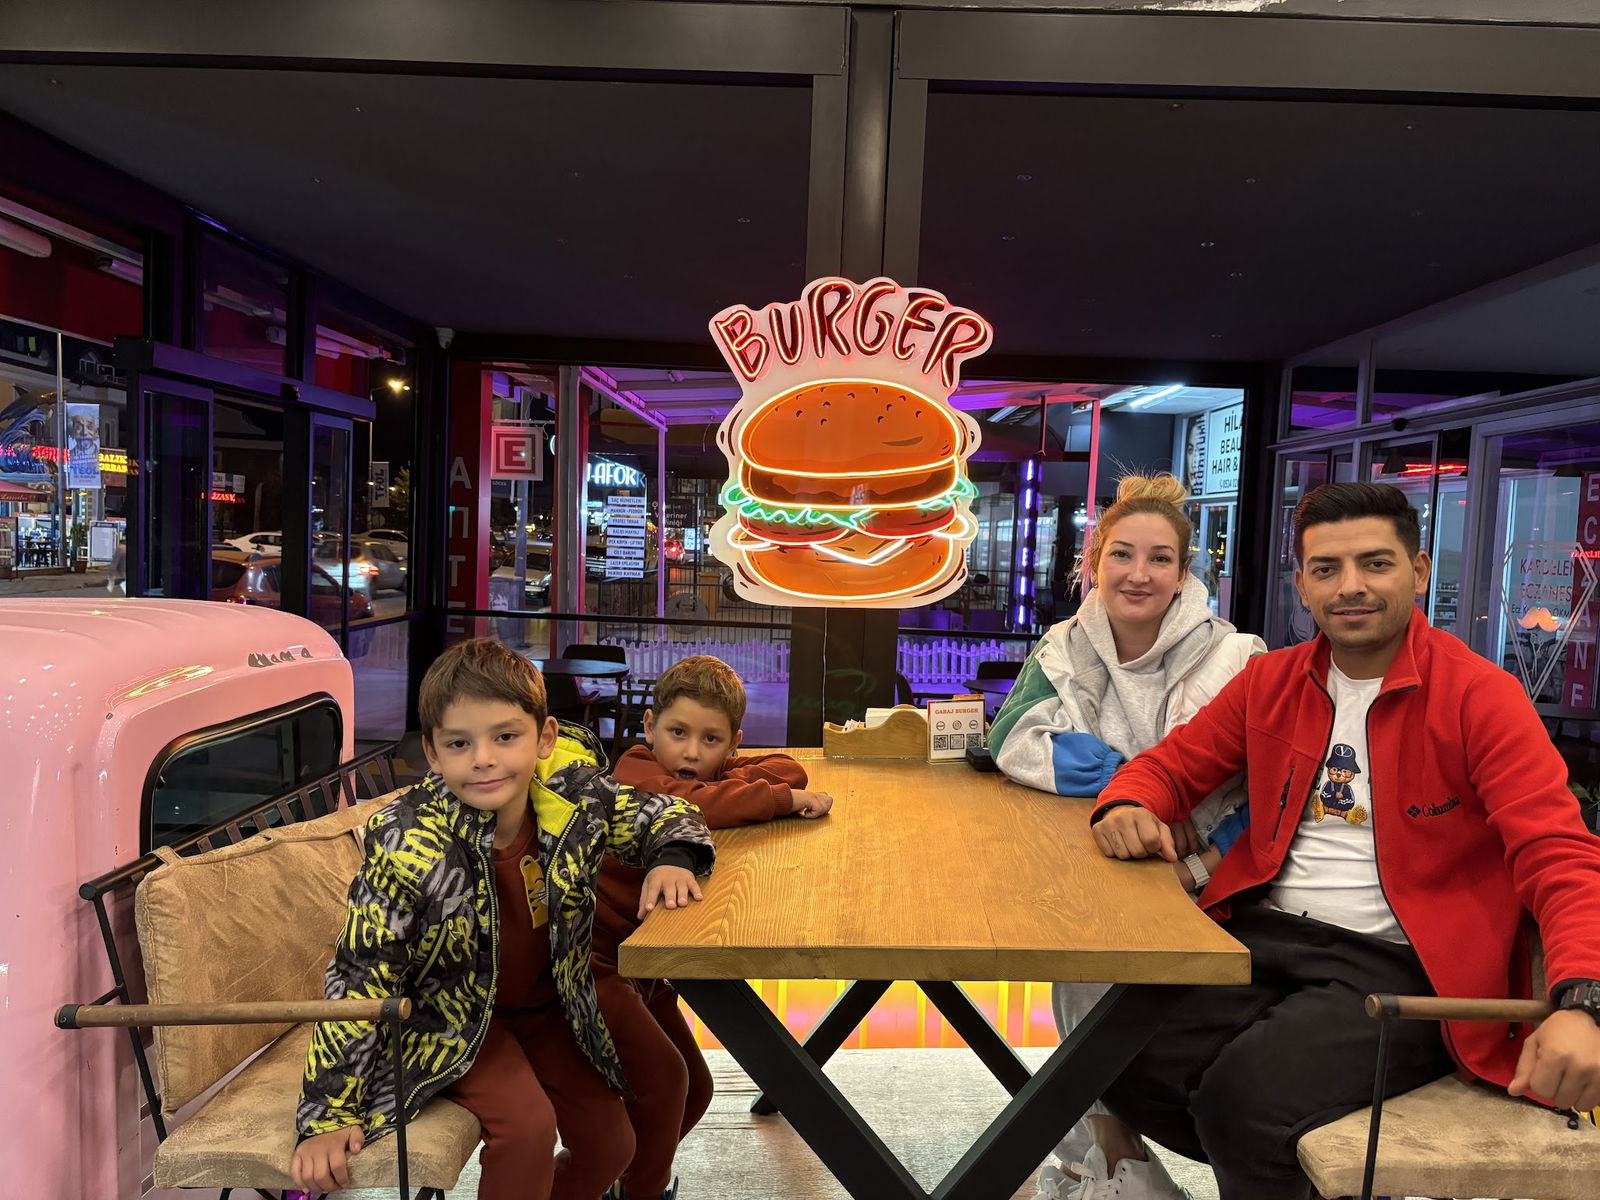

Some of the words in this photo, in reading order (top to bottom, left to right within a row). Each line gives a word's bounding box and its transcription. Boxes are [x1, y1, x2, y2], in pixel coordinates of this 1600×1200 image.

[714, 276, 988, 389] BURGER
[1212, 457, 1231, 475] HAIR
[1422, 796, 1462, 818] Columbia
